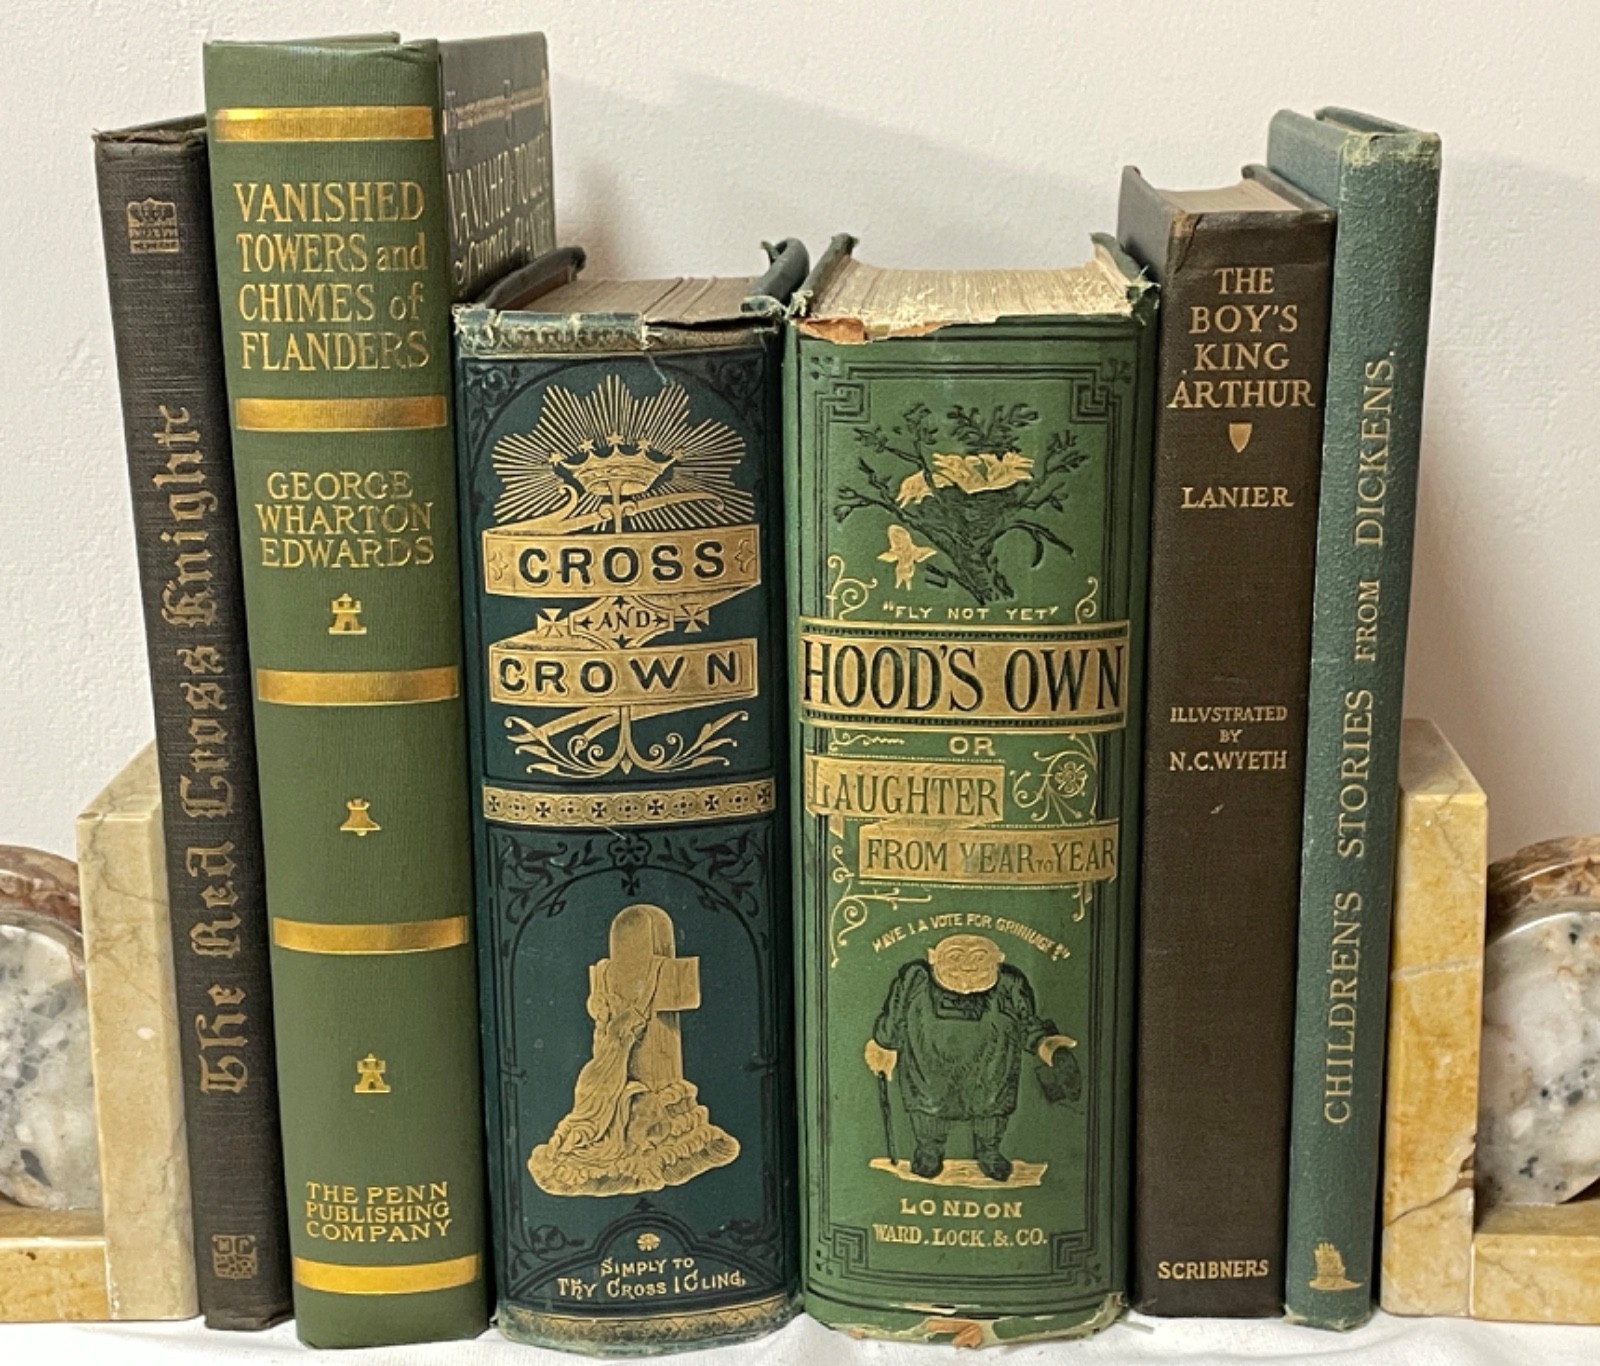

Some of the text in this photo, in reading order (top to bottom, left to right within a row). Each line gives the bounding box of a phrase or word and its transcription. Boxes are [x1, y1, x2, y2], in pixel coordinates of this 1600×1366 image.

[232, 181, 425, 222] VANISHED
[235, 232, 368, 273] TOWERS
[375, 231, 428, 272] and
[1212, 266, 1275, 295] THE
[239, 281, 424, 322] CHIMES of
[1188, 304, 1298, 335] BOY'S
[239, 330, 430, 371] FLANDERS
[1193, 342, 1290, 371] KING
[1165, 380, 1316, 409] ARTHUR
[266, 470, 414, 501] GEORGE
[1180, 486, 1296, 509] LANIER
[254, 502, 434, 535] WHARTON
[259, 535, 435, 569] EDWARDS
[519, 540, 725, 584] CROSS
[597, 607, 651, 630] AND
[882, 601, 1060, 621] "FLY NOT YET"
[499, 650, 737, 694] CROWN
[803, 640, 1125, 713] HOOD'S OWN
[1169, 705, 1289, 723] ILLVSTRATED
[175, 643, 234, 819] Cross
[948, 736, 996, 757] OR
[1219, 728, 1243, 744] BY
[1323, 350, 1396, 1124] CHILDREN'S STORIES FROM DICKENS.
[811, 759, 1000, 817] LAUGHTER
[867, 839, 948, 872] FROM
[960, 842, 1035, 875] YEAR
[1051, 837, 1116, 873] YEAR
[185, 840, 242, 959] Red
[871, 926, 907, 953] HAVE
[907, 922, 916, 935] I
[918, 919, 929, 933] A
[929, 913, 964, 930] VOTE
[966, 913, 993, 929] FOR
[195, 983, 249, 1095] The
[306, 1181, 448, 1205] THE PENN
[899, 1198, 1023, 1219] LONDON
[306, 1200, 450, 1223] PUBLISHING
[306, 1218, 453, 1242] COMPANY
[671, 1256, 696, 1269] TO
[1157, 1259, 1270, 1280] SCRIBNERS
[606, 1275, 667, 1299] CROSS
[673, 1275, 681, 1294] I
